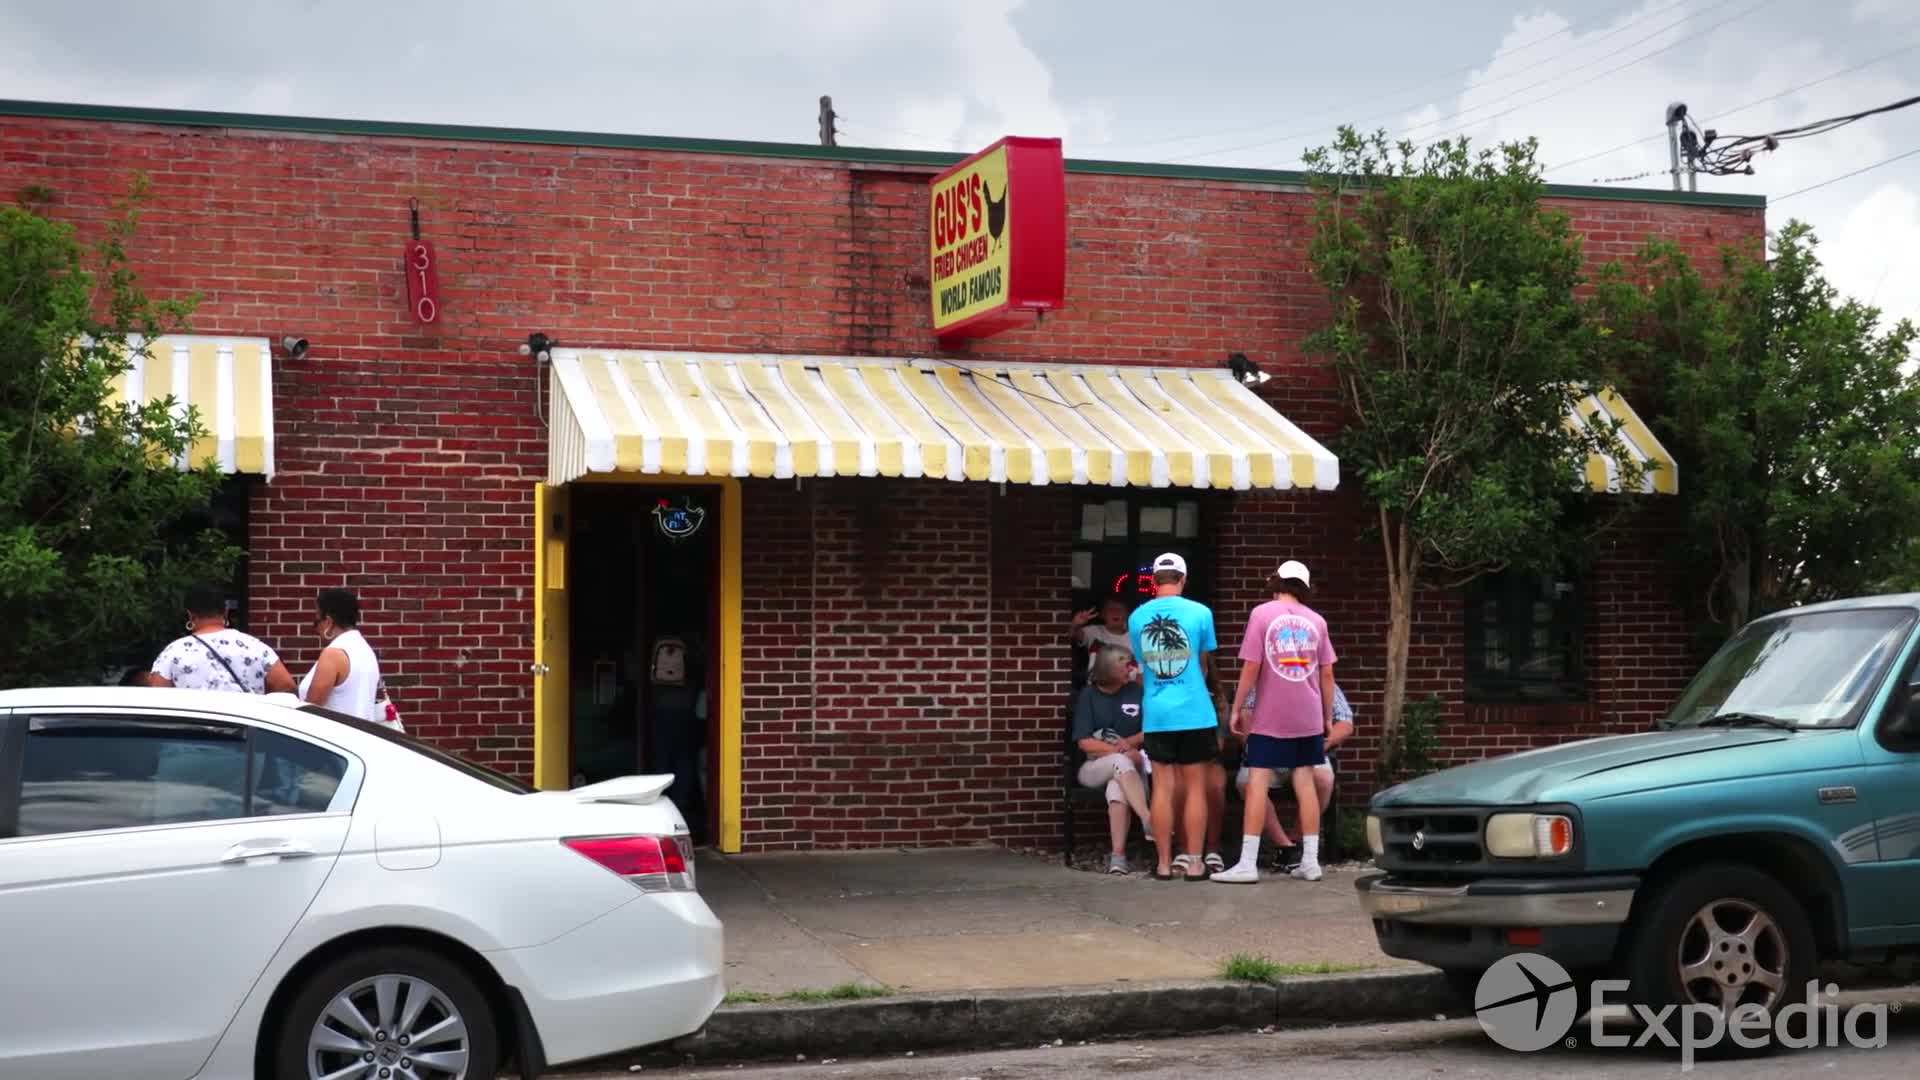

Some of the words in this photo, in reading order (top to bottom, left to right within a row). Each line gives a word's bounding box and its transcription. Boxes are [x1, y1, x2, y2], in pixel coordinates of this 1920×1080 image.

[934, 172, 981, 250] GUS'S
[414, 245, 435, 322] 310
[933, 250, 954, 282] FRIED
[956, 234, 988, 273] CHICKEN
[940, 281, 967, 316] WORLD
[969, 266, 1001, 305] FAMOUS
